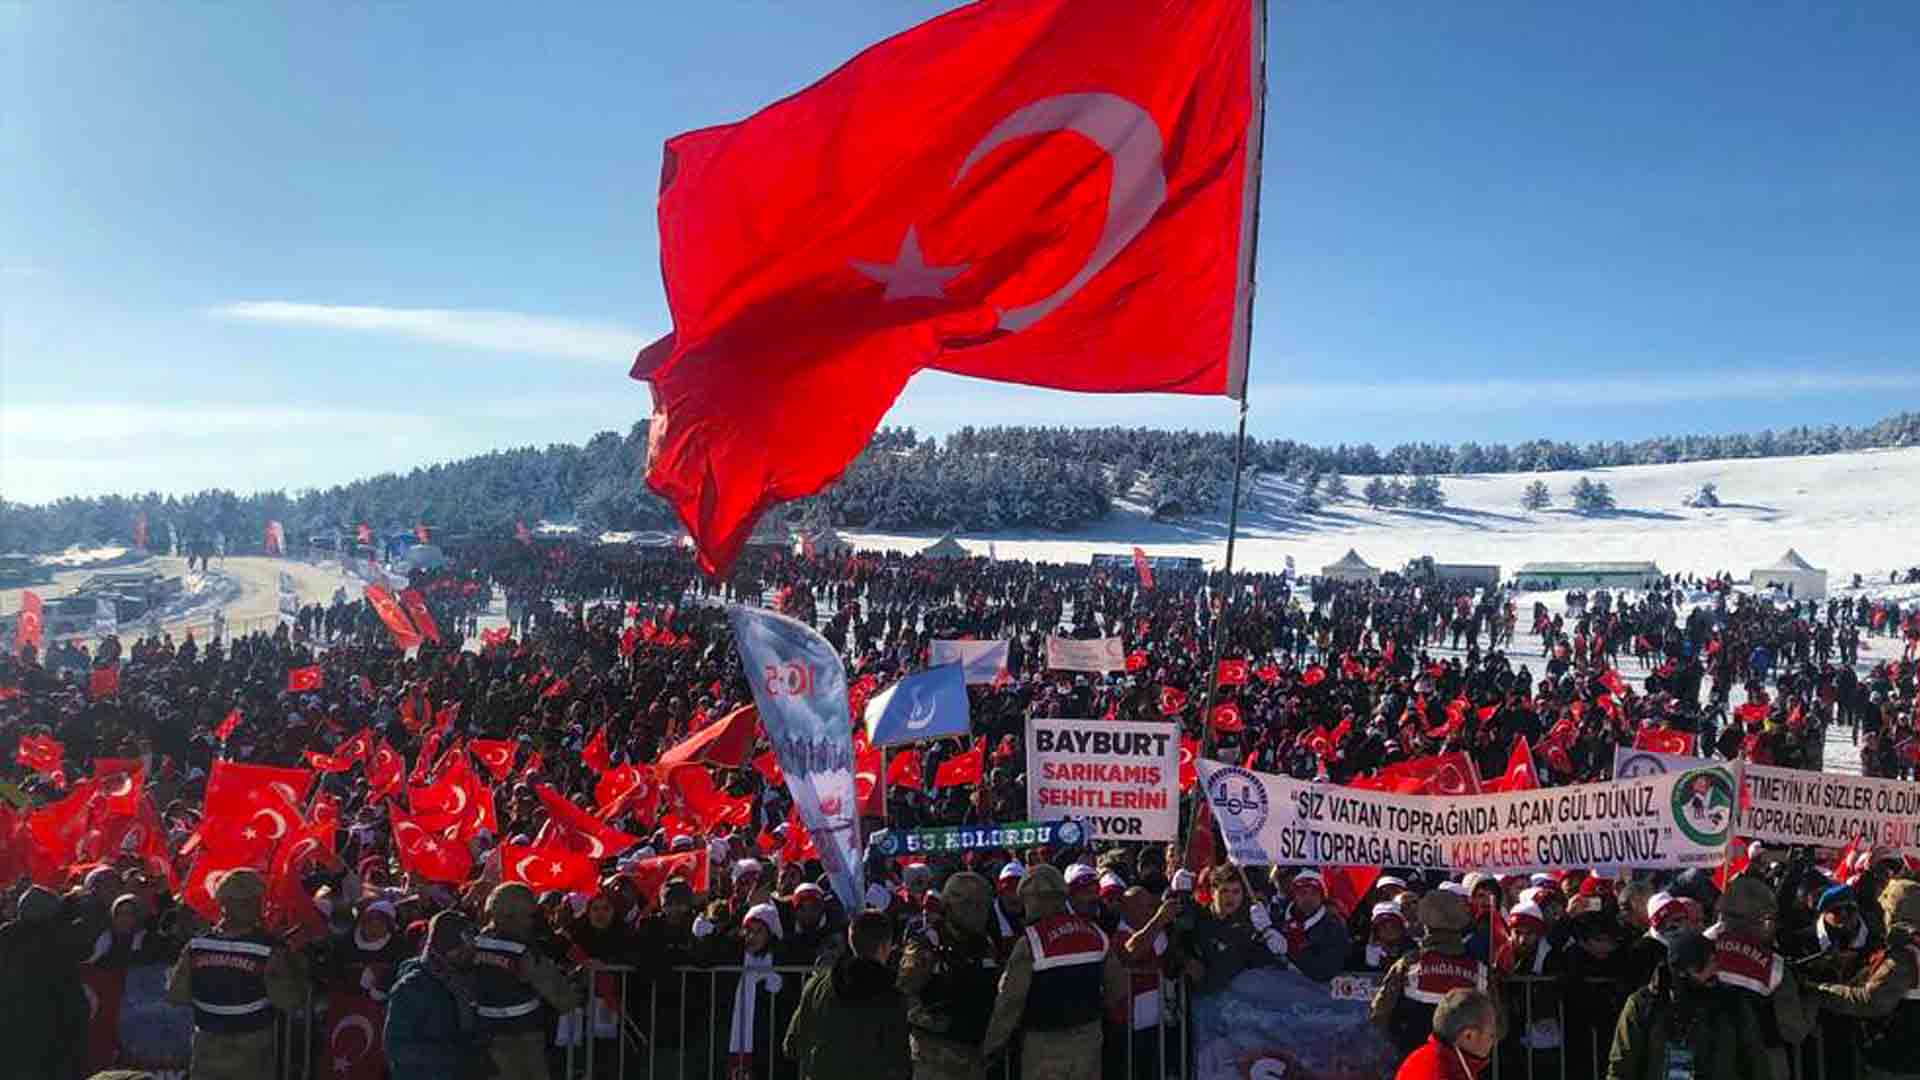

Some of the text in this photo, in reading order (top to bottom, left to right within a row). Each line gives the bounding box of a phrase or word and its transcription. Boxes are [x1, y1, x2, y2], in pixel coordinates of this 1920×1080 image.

[1036, 729, 1170, 757] BAYBURT
[1041, 762, 1162, 786] SARIKAMIŞ
[1038, 785, 1169, 810] ŞEHİTLERİNİ
[1807, 777, 1823, 807] Kİ
[1824, 779, 1873, 813] SİZLER
[1329, 796, 1382, 830] VATAN
[1387, 802, 1499, 838] TOPRAĞINDA
[1505, 798, 1553, 833] AÇAN
[1747, 805, 1838, 842] TOPRAĞINDA
[1280, 821, 1307, 861] SİZ
[1311, 830, 1393, 866] TOPRAĞA
[1398, 836, 1449, 869] DEĞİL
[1451, 835, 1531, 869] KALPLERE
